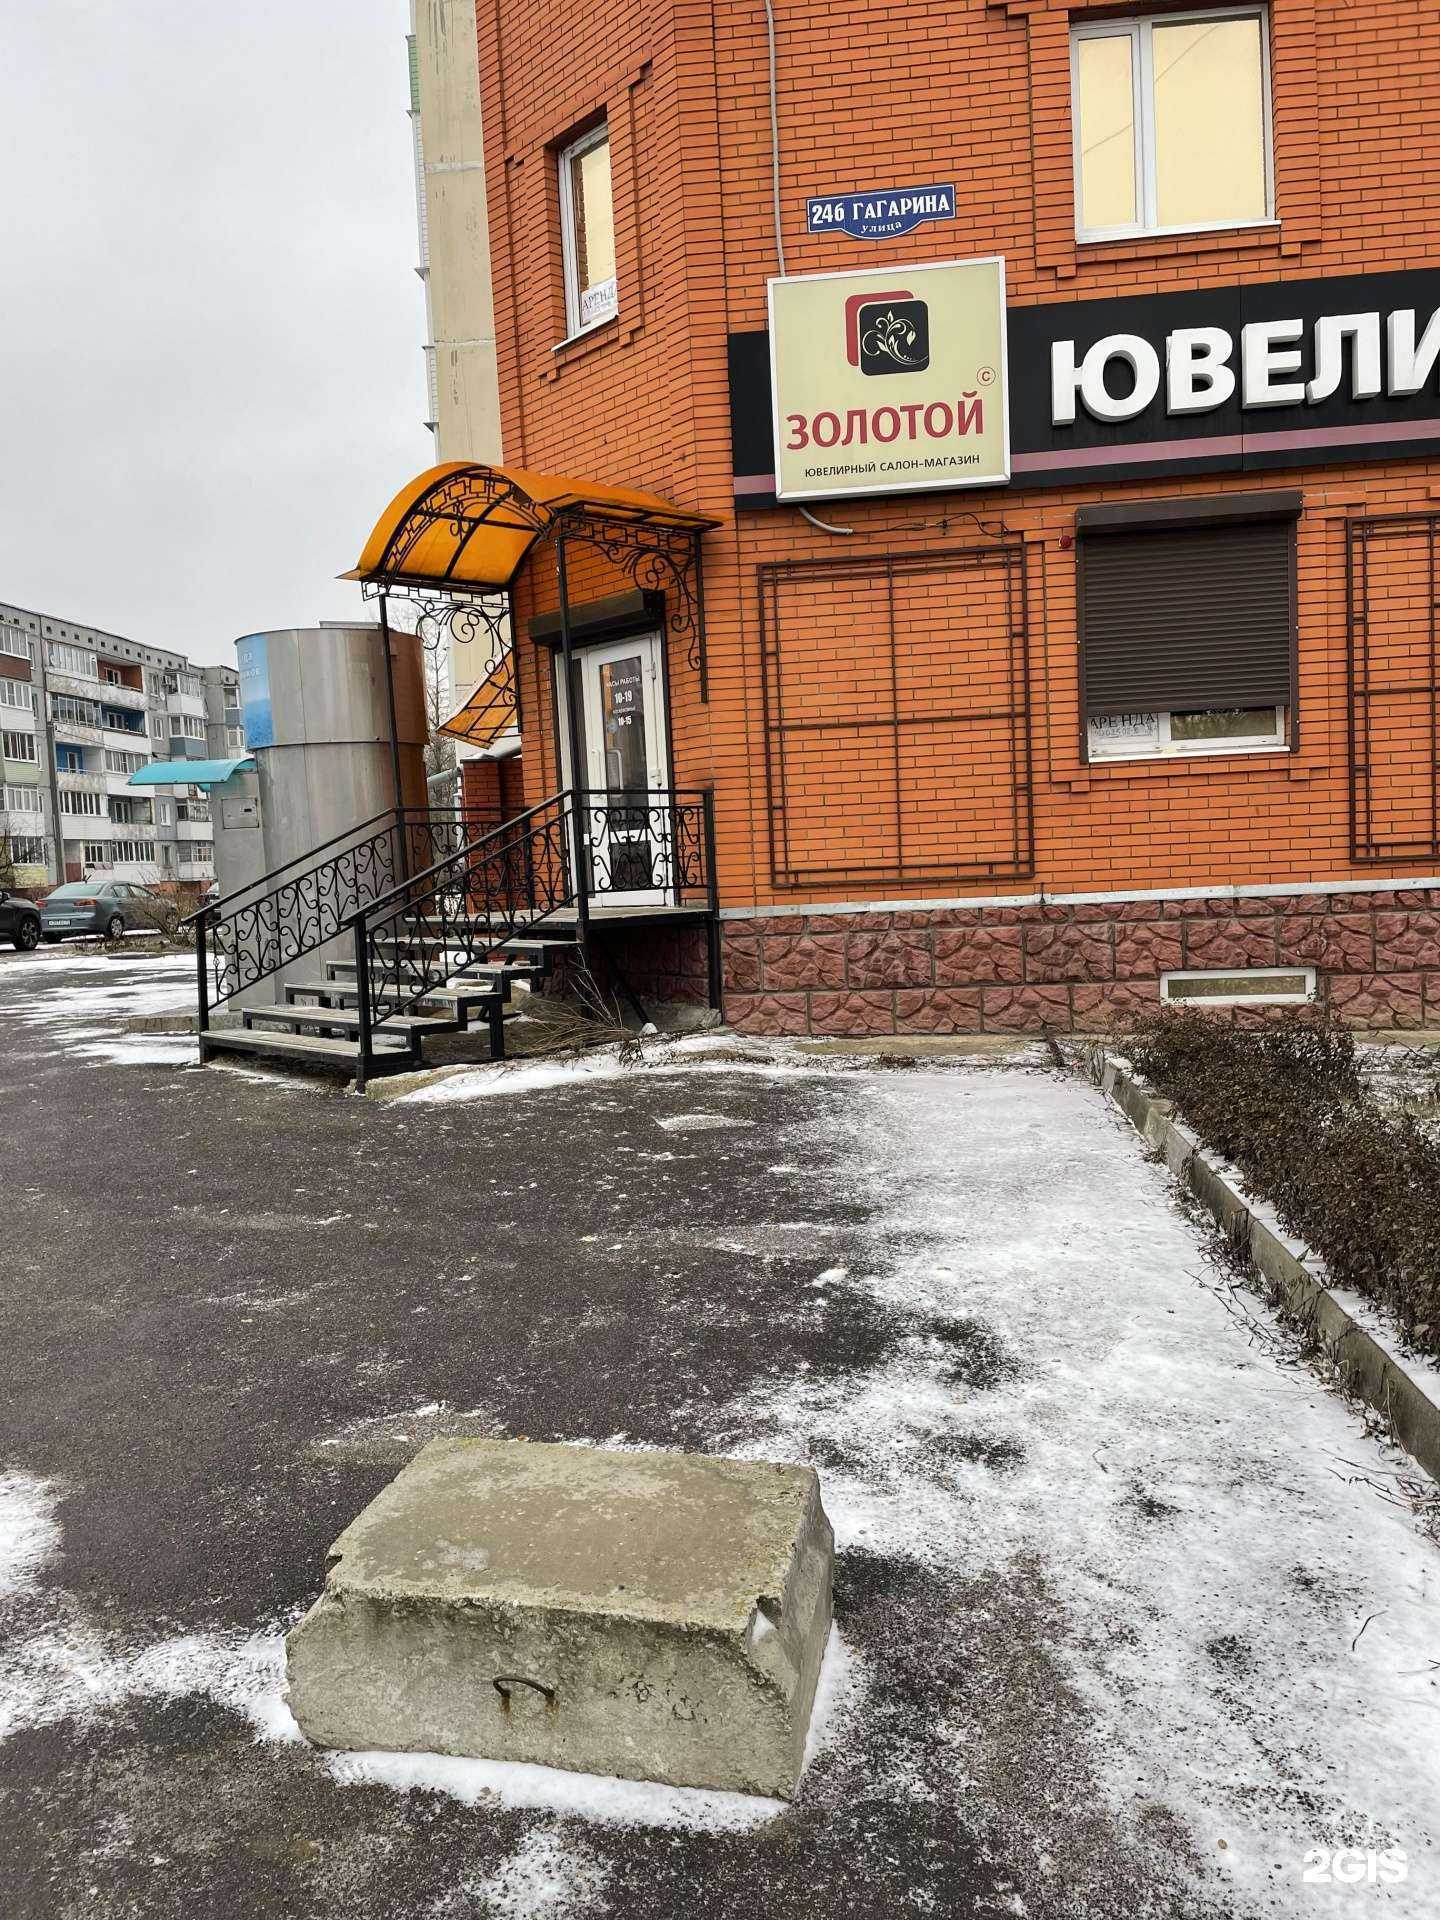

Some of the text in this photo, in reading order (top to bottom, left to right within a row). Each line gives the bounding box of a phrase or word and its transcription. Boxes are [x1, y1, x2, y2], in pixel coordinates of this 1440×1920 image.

[852, 194, 950, 220] ГАГАРИНА
[861, 221, 902, 233] улица
[786, 390, 984, 451] ЗОЛОТОЙ
[804, 454, 981, 477] ЮВЕЛИРНЫЙ САЛОН-МАГАЗИН
[614, 689, 633, 704] 10-19
[1090, 712, 1155, 730] АРЕНДА
